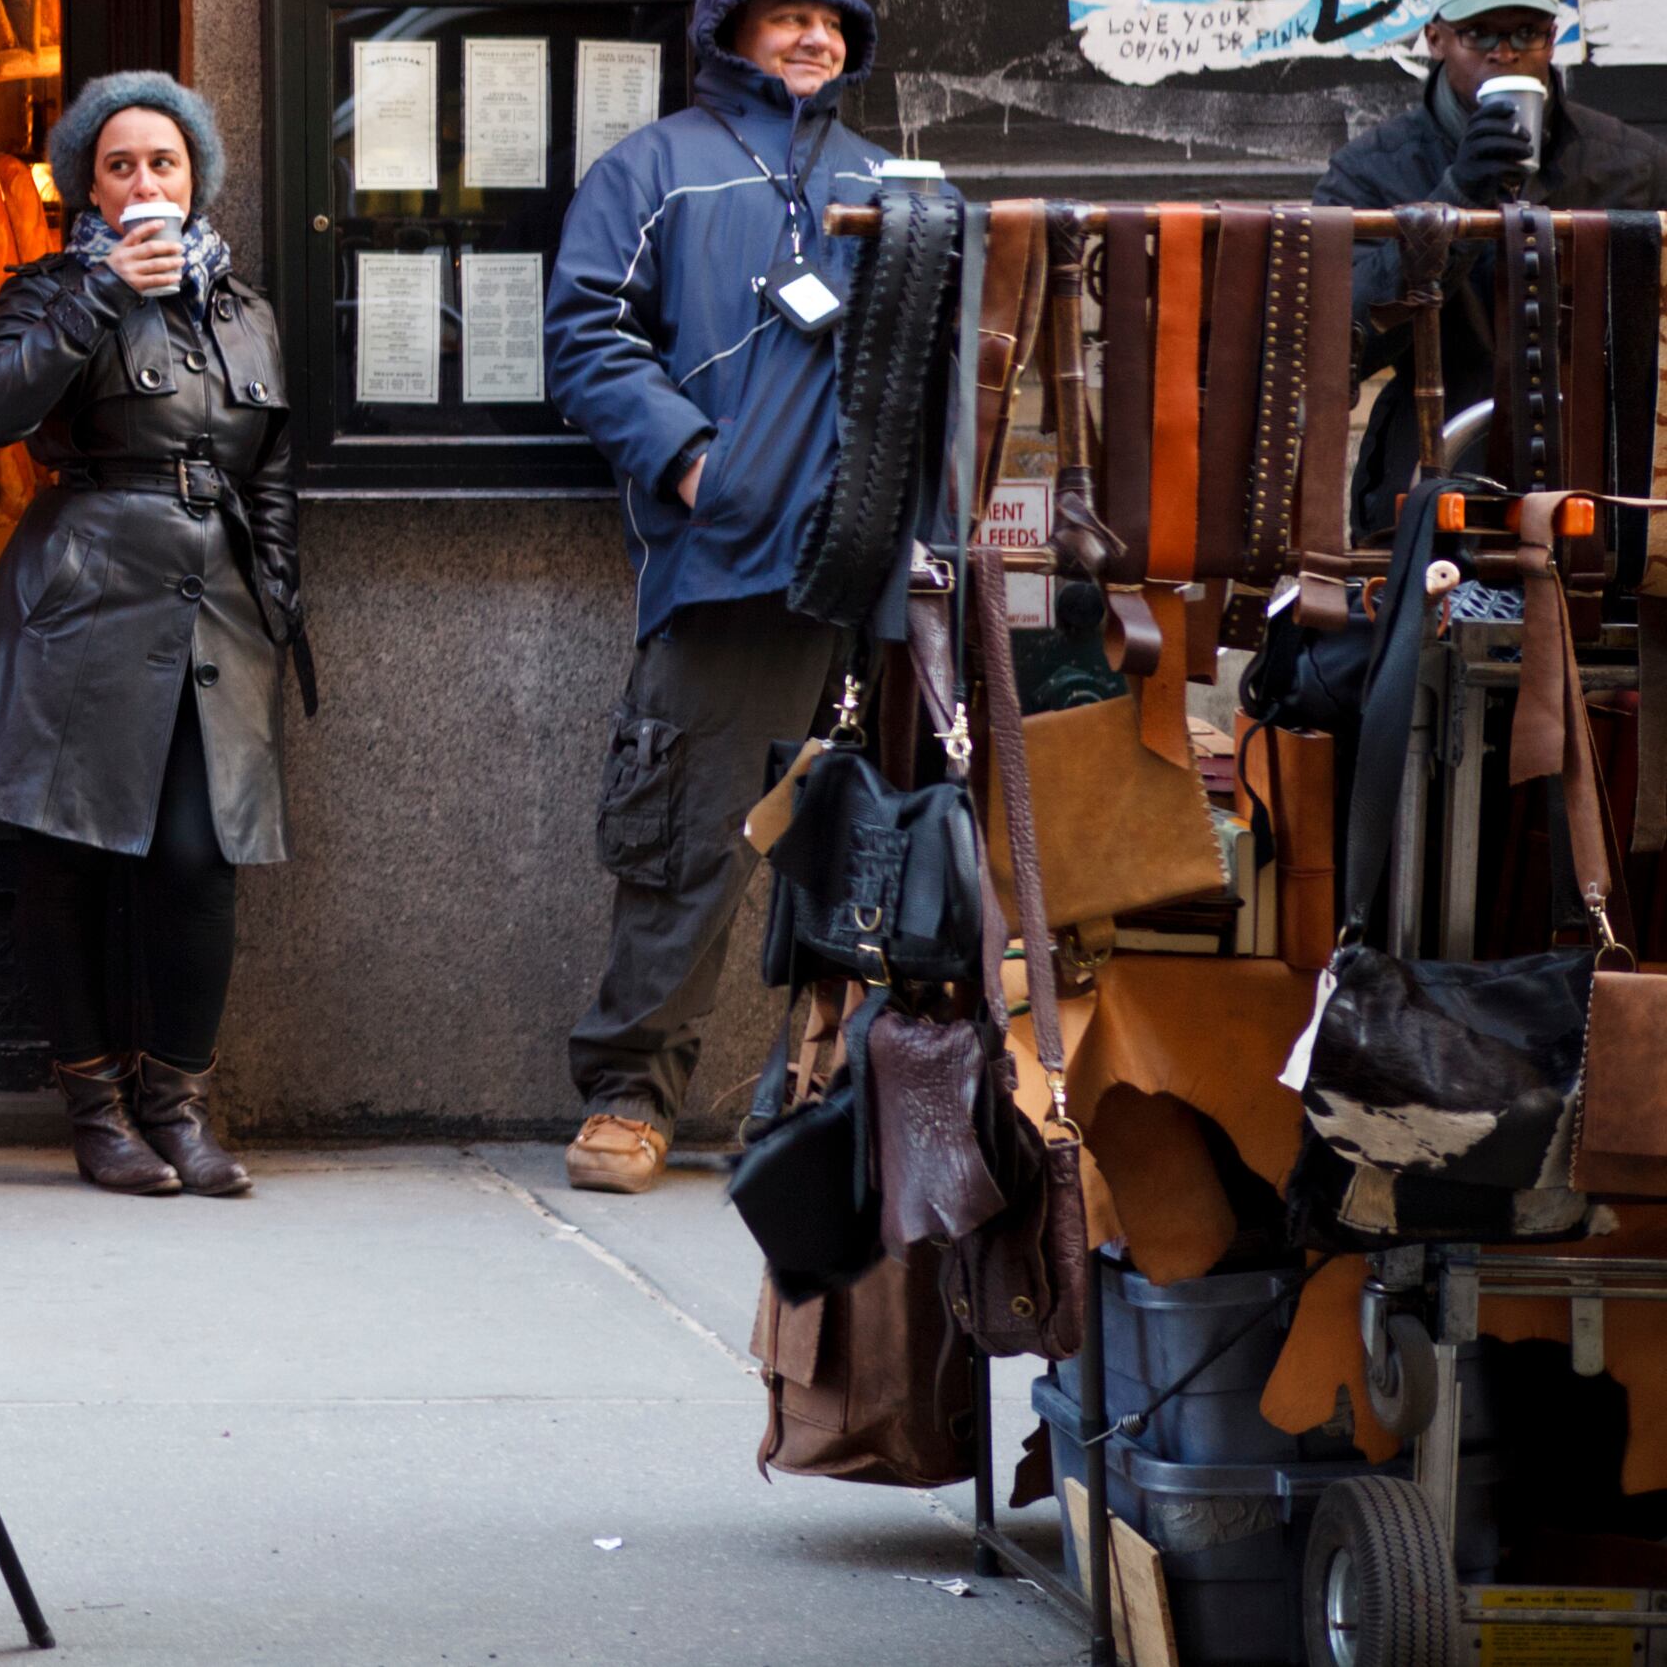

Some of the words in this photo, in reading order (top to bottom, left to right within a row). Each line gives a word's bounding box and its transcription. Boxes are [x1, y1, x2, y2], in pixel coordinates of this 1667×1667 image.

[1108, 13, 1168, 36] LOVE
[1212, 32, 1244, 51] DR
[1256, 16, 1310, 52] PINK
[986, 501, 1025, 522] ENT
[989, 527, 1039, 547] FEEDS
